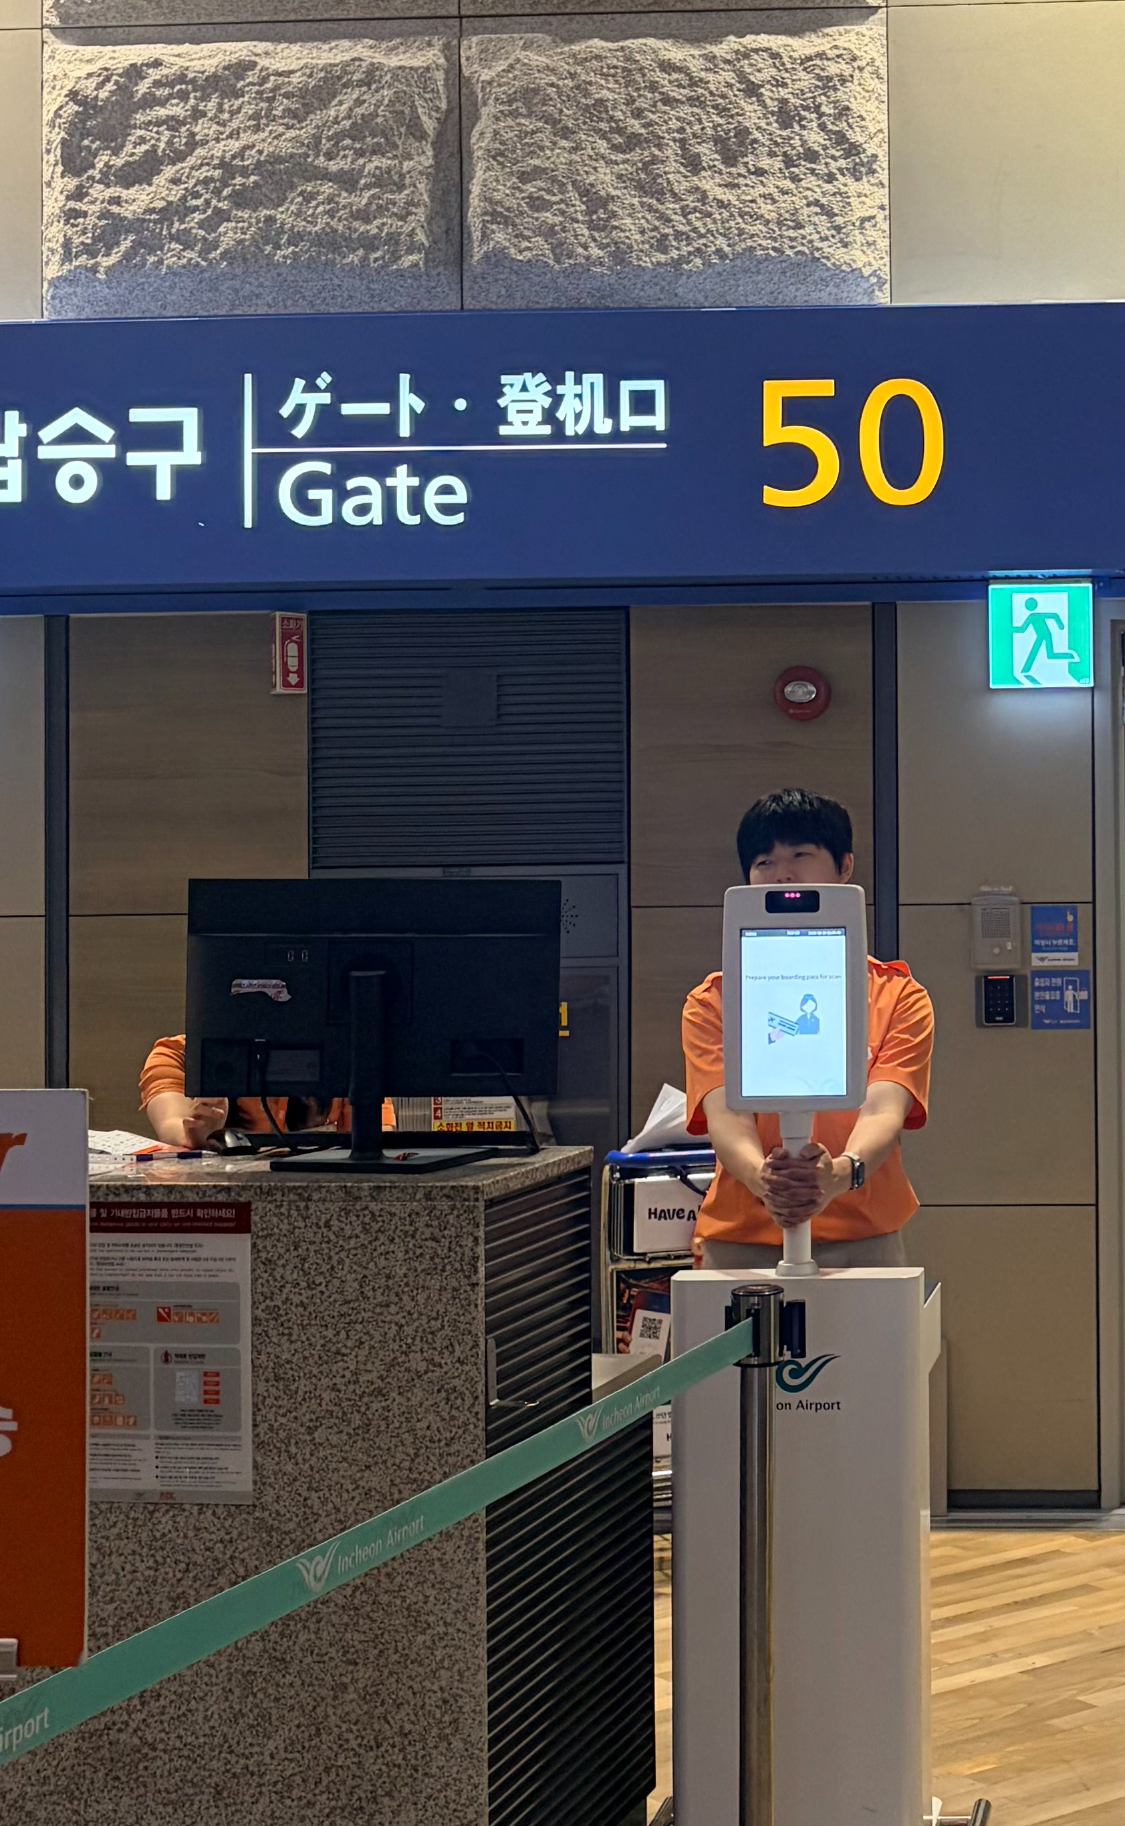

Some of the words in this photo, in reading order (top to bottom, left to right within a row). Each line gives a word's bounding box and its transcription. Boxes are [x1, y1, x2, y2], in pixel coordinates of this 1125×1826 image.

[762, 378, 944, 508] 50
[279, 462, 469, 527] Gate
[171, 1208, 194, 1219] 반드시
[602, 1403, 633, 1431] Incheon
[635, 1385, 660, 1410] Airport
[796, 1399, 842, 1413] Airport
[337, 1538, 383, 1575] Incheon
[386, 1514, 424, 1548] Airport
